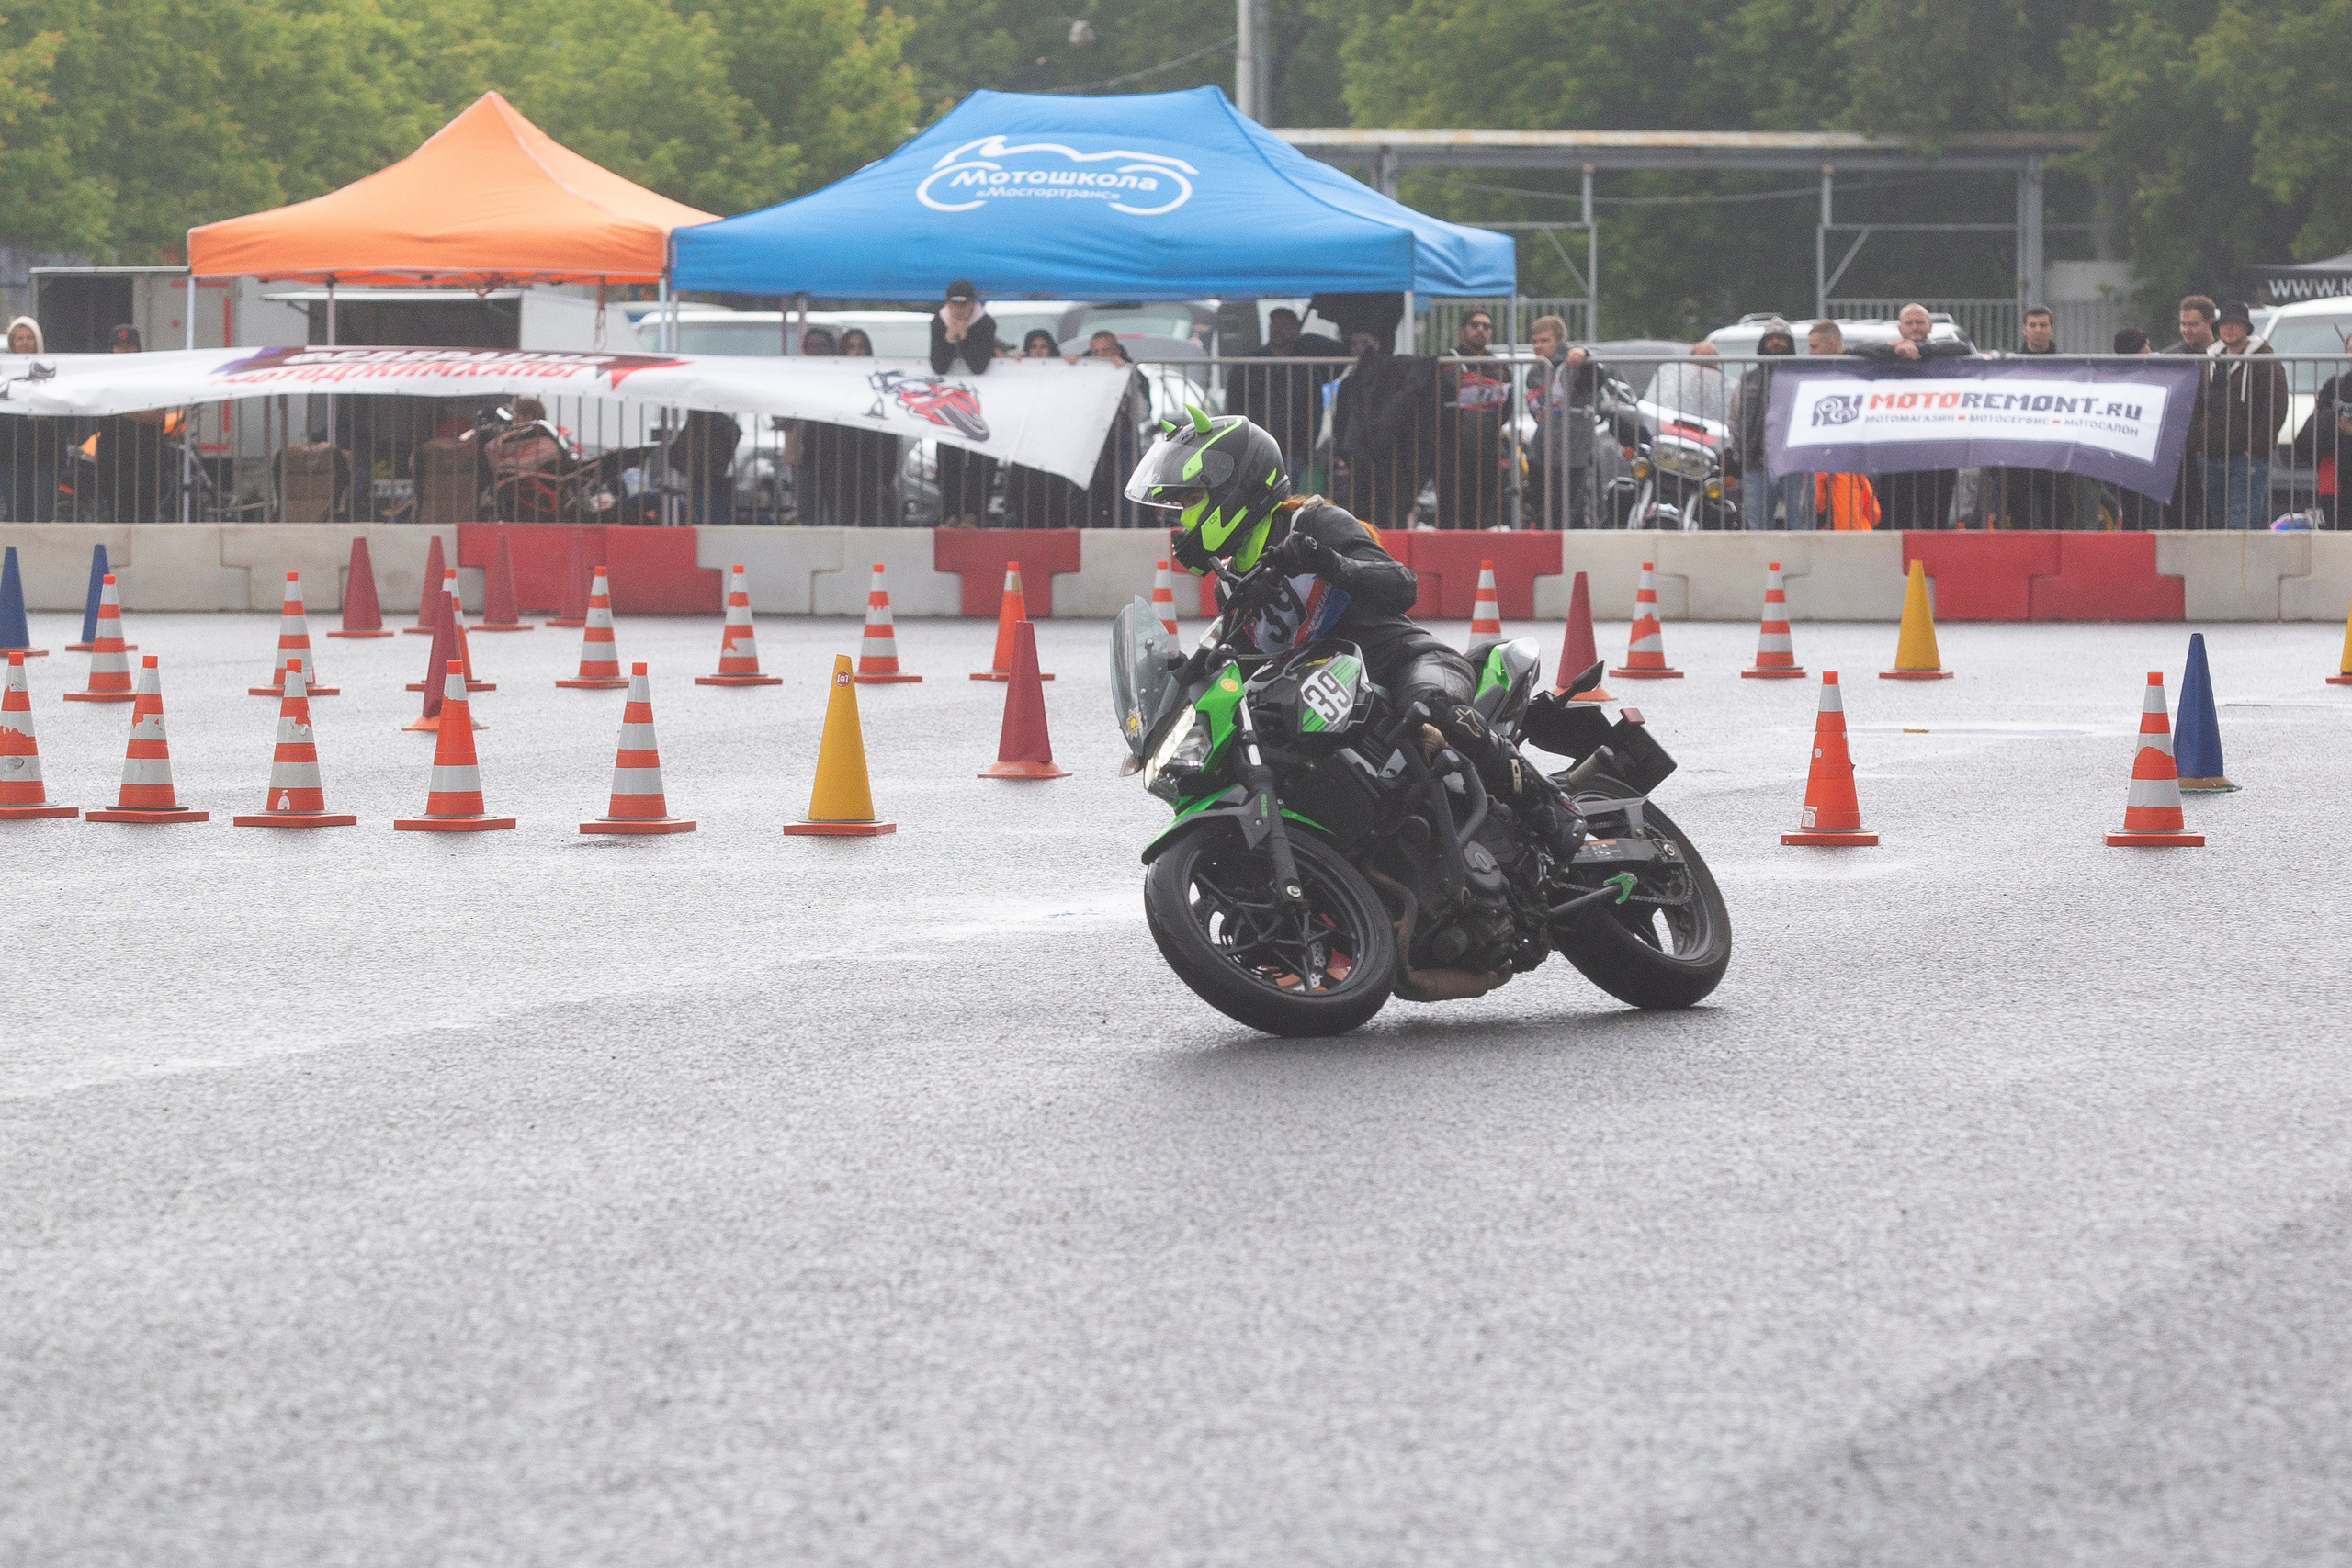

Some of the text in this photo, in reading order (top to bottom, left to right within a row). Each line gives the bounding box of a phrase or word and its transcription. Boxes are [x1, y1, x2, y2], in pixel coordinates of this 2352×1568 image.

[950, 169, 1159, 191] Мотошкола
[1869, 392, 2142, 421] MOTOREMONT.RU
[1304, 671, 1351, 722] 39
